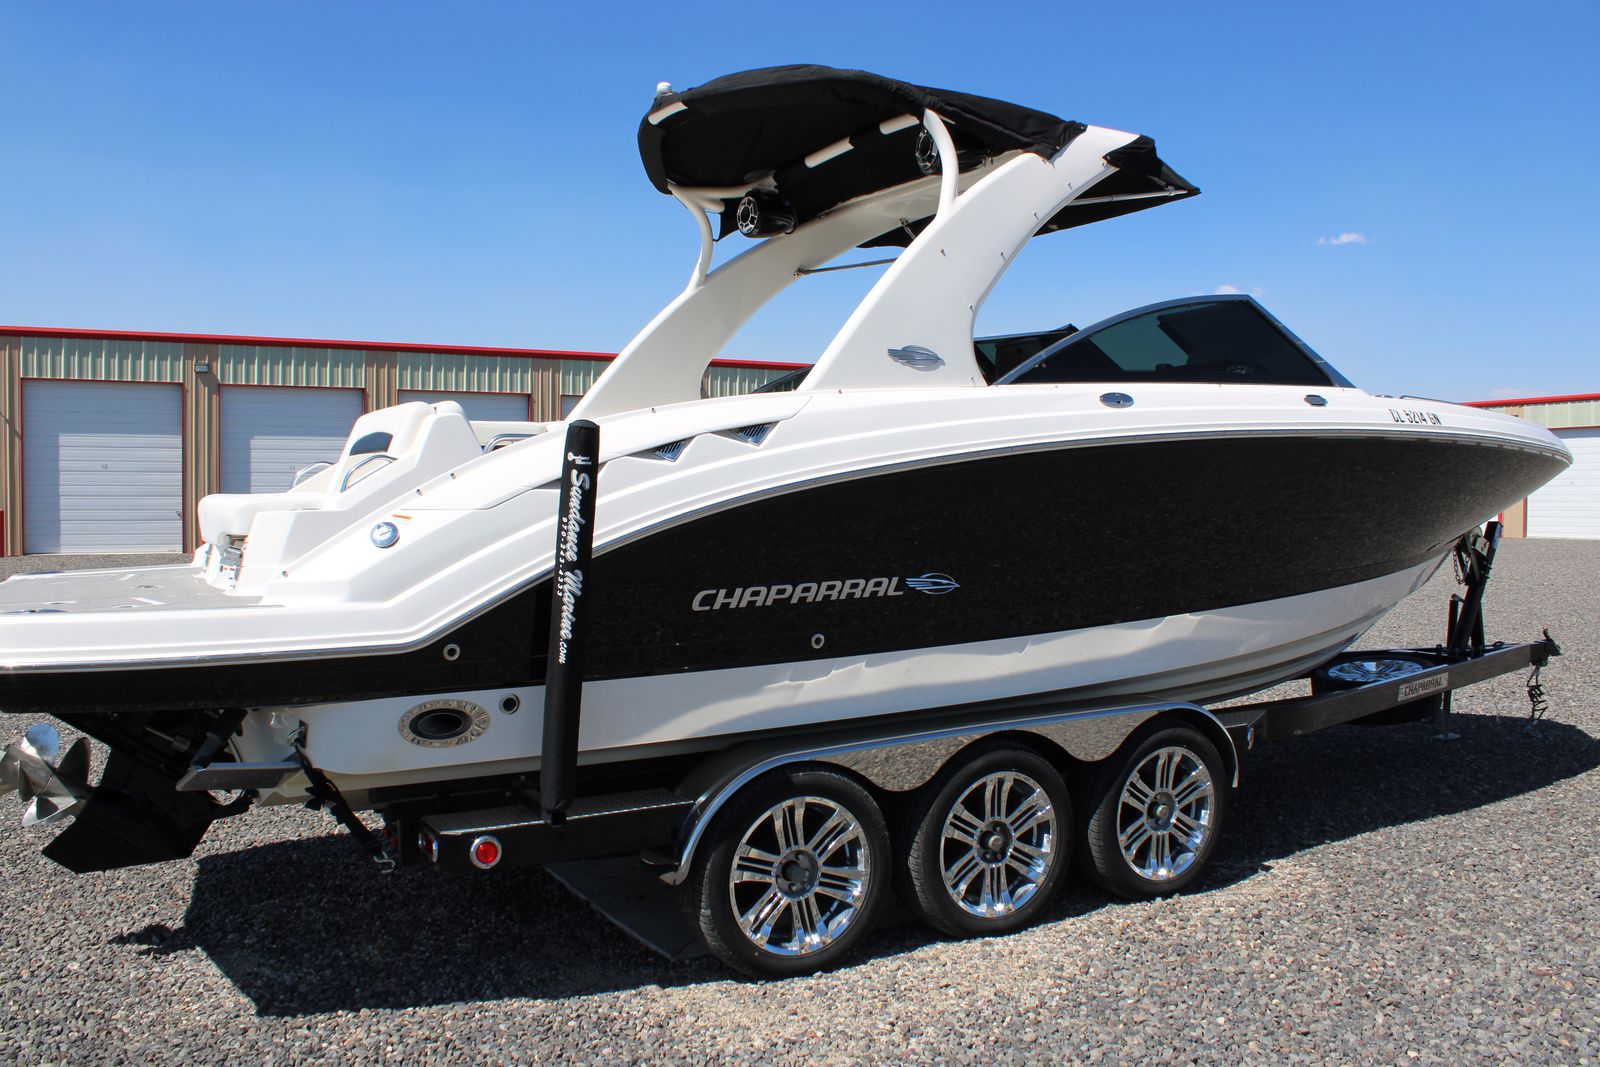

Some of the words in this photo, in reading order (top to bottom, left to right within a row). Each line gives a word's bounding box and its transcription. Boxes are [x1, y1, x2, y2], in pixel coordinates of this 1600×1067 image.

[101, 463, 109, 471] 10
[566, 469, 590, 562] Sundance
[691, 576, 905, 612] CHAPARRAL
[1404, 677, 1442, 696] CHAPARRAL
